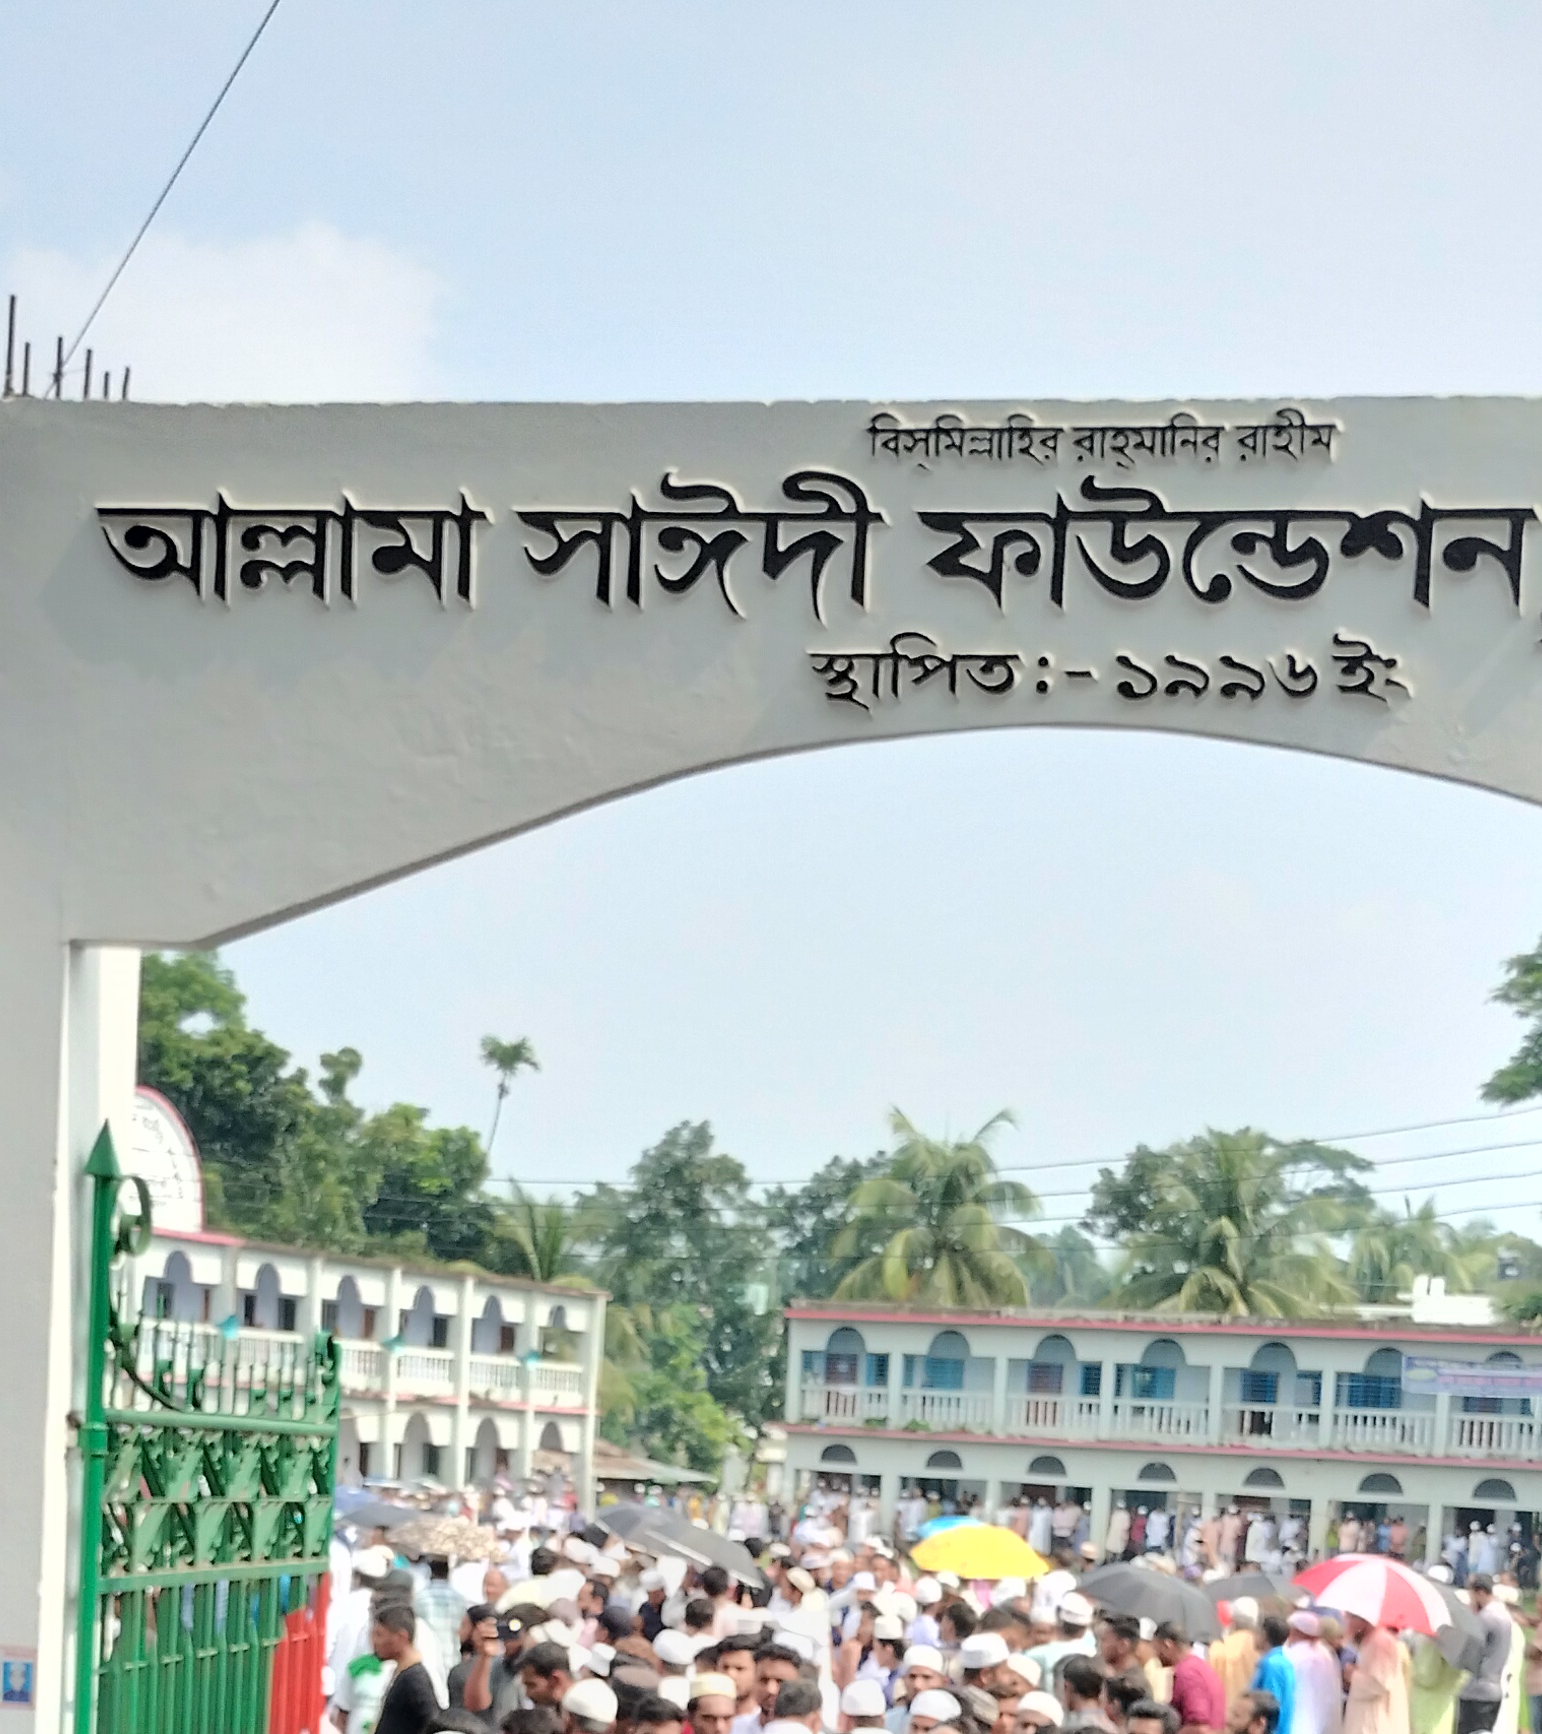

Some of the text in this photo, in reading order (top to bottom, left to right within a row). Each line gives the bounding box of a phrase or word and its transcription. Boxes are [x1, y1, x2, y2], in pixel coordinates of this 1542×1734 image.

[1235, 408, 1336, 462] রাহীম
[94, 491, 489, 604] আল্লামা
[514, 471, 886, 621] সাঈদী
